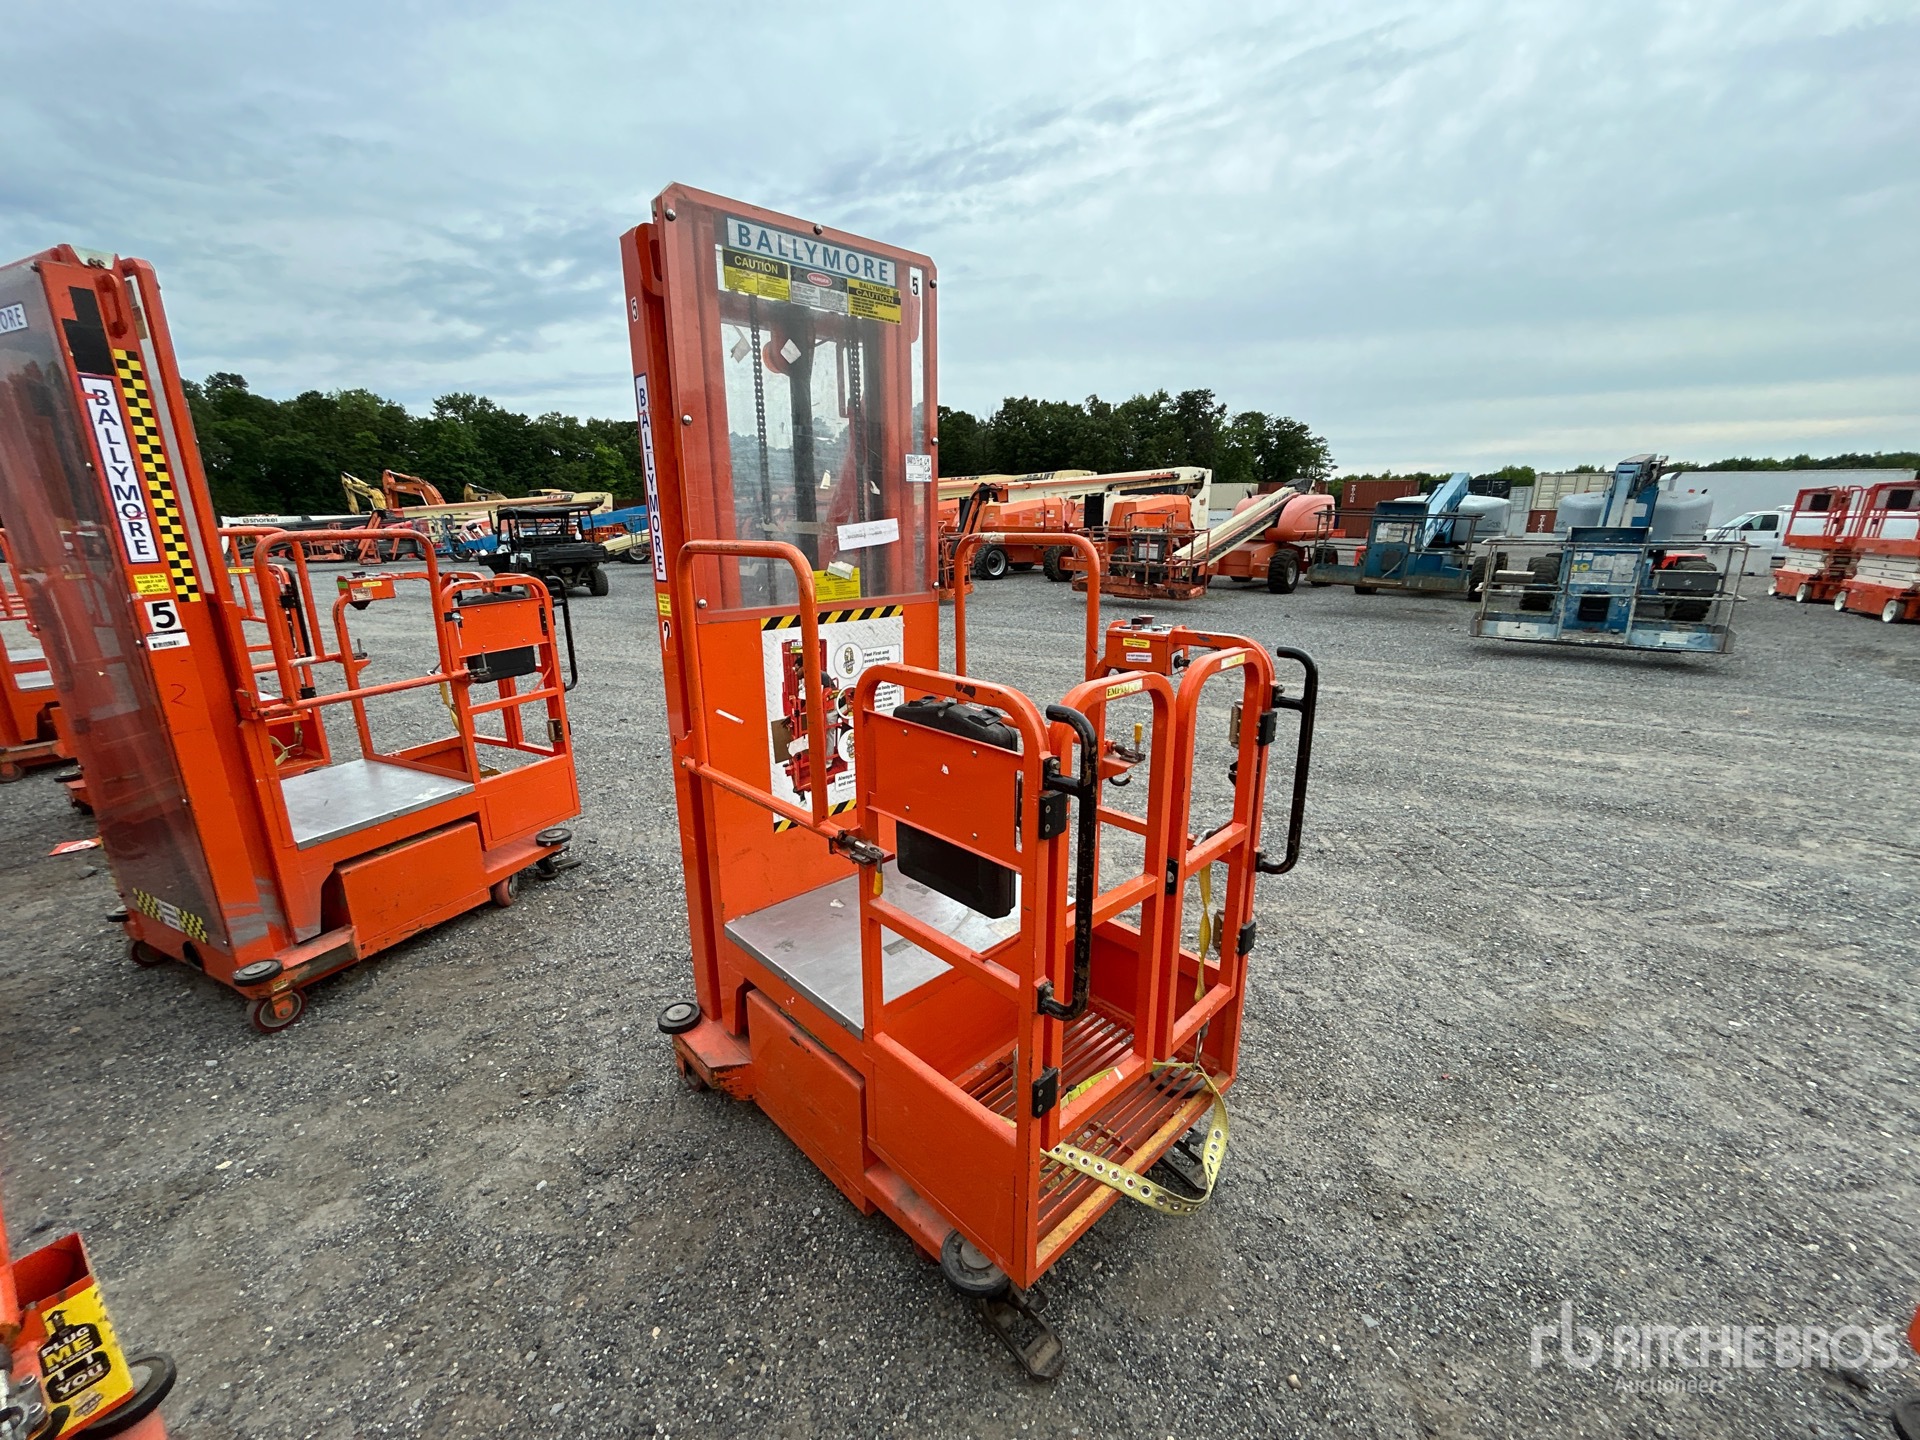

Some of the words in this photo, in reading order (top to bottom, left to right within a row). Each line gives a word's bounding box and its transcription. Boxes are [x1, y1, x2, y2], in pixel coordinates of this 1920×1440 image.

[734, 255, 778, 274] CAUTION
[738, 223, 889, 282] BALLYMORE
[856, 289, 894, 303] CAUTION
[859, 282, 891, 295] BALLYMORE
[912, 276, 919, 295] 5
[93, 388, 150, 556] BALLYMORE
[639, 388, 664, 574] BALLYMORE
[152, 602, 176, 628] 5
[170, 683, 194, 708] 2
[41, 1326, 90, 1358] PLUG
[44, 1333, 93, 1368] ME
[61, 1343, 95, 1366] TODAY
[56, 1363, 104, 1394] YOU
